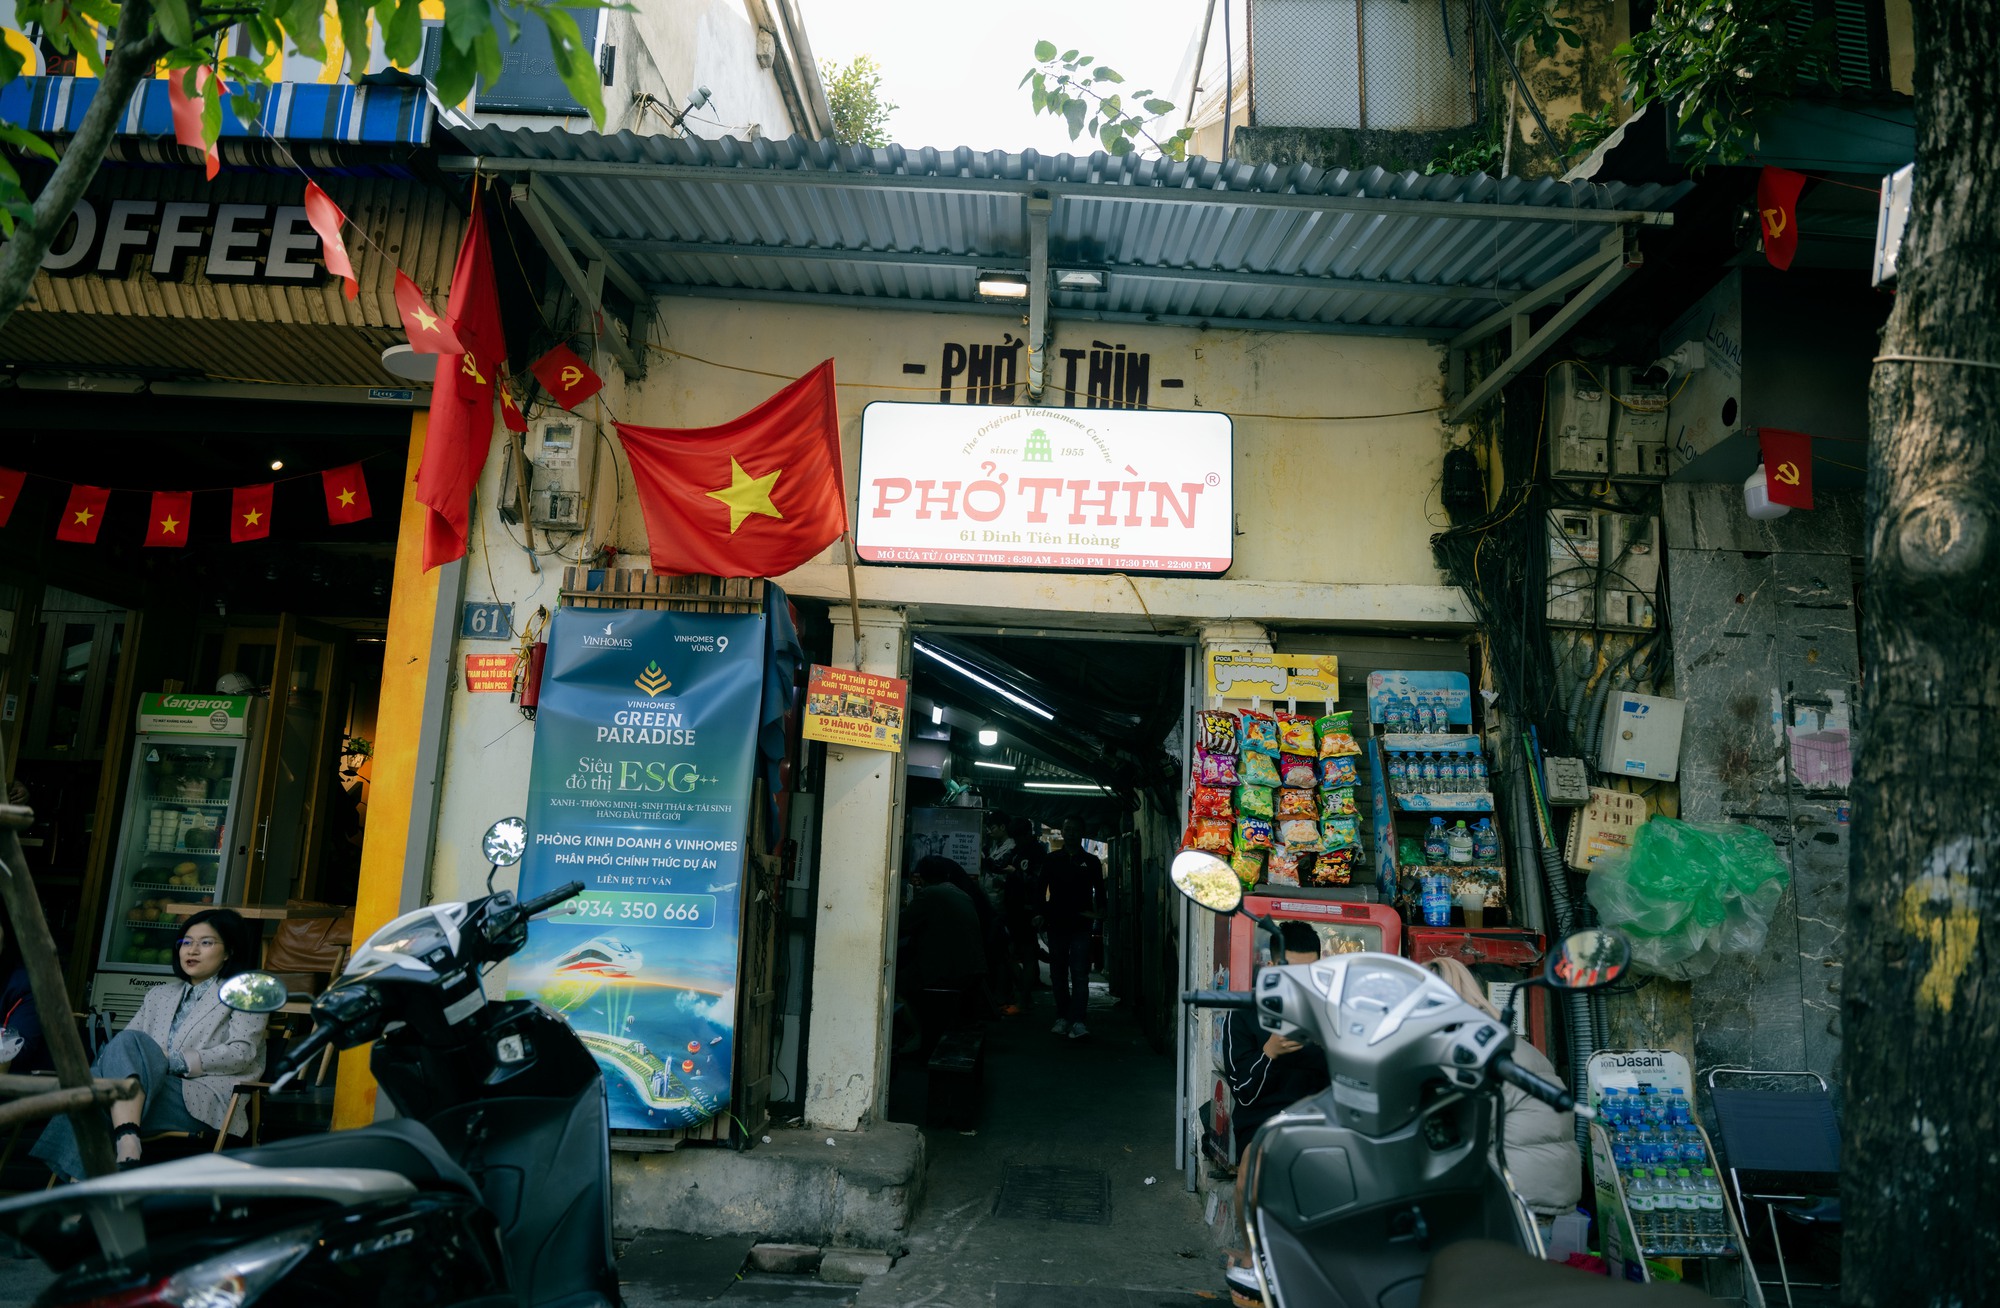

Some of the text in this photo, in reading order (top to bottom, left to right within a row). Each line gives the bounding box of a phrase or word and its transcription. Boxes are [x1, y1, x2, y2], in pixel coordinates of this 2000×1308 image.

[0, 199, 320, 279] OFFEE
[940, 333, 1024, 404] PHỞ
[962, 408, 1112, 464] The Original Vietnamese Cuisine
[990, 446, 1085, 457] since 1955
[872, 460, 1205, 529] PHỞ THÌN
[959, 530, 977, 542] 61
[1027, 531, 1062, 545] Tiên
[1068, 533, 1120, 549] Hoàng
[877, 548, 895, 560] MỞ
[897, 548, 920, 560] CỬA
[922, 549, 937, 561] TỪ
[945, 553, 975, 562] OPEN
[978, 553, 1005, 562] TIME
[1013, 555, 1032, 564] 6:30
[1034, 555, 1051, 564] AM
[1060, 557, 1085, 565] 13:00
[1087, 557, 1103, 566] PM
[1115, 559, 1140, 567] 17:30
[1142, 559, 1159, 568] PM
[1167, 560, 1192, 569] 22:00
[1195, 561, 1211, 569] PM
[471, 608, 499, 633] 61
[583, 635, 632, 648] VINHOMES
[674, 635, 729, 652] VINHOMES 9
[691, 643, 714, 652] VÙNG
[849, 674, 866, 685] THÌN
[157, 695, 232, 711] Kangaroo
[627, 700, 675, 710] VINHOMES
[614, 710, 682, 728] GREEN
[819, 718, 872, 732] 19 HÀNG VÔI
[597, 726, 696, 746] PARADISE
[578, 756, 613, 774] Siêu
[566, 773, 611, 793] đô thị
[550, 798, 575, 807] XANH
[580, 799, 611, 809] THÔNG
[613, 801, 637, 810] MINH
[642, 802, 663, 810] SINH
[665, 802, 686, 811] THÁI
[695, 803, 710, 812] TÁI
[710, 804, 732, 813] SINH
[596, 809, 622, 819] HÀNG
[536, 832, 738, 851] PHÒNG KINH DOANH 6 VINHOMES
[555, 851, 717, 871] PHÂN PHỐI CHÍNH THỨC DỰ ÁN
[597, 873, 619, 884] LIÊN
[621, 874, 634, 886] HỆ
[620, 901, 657, 919] 350
[663, 903, 699, 921] 666
